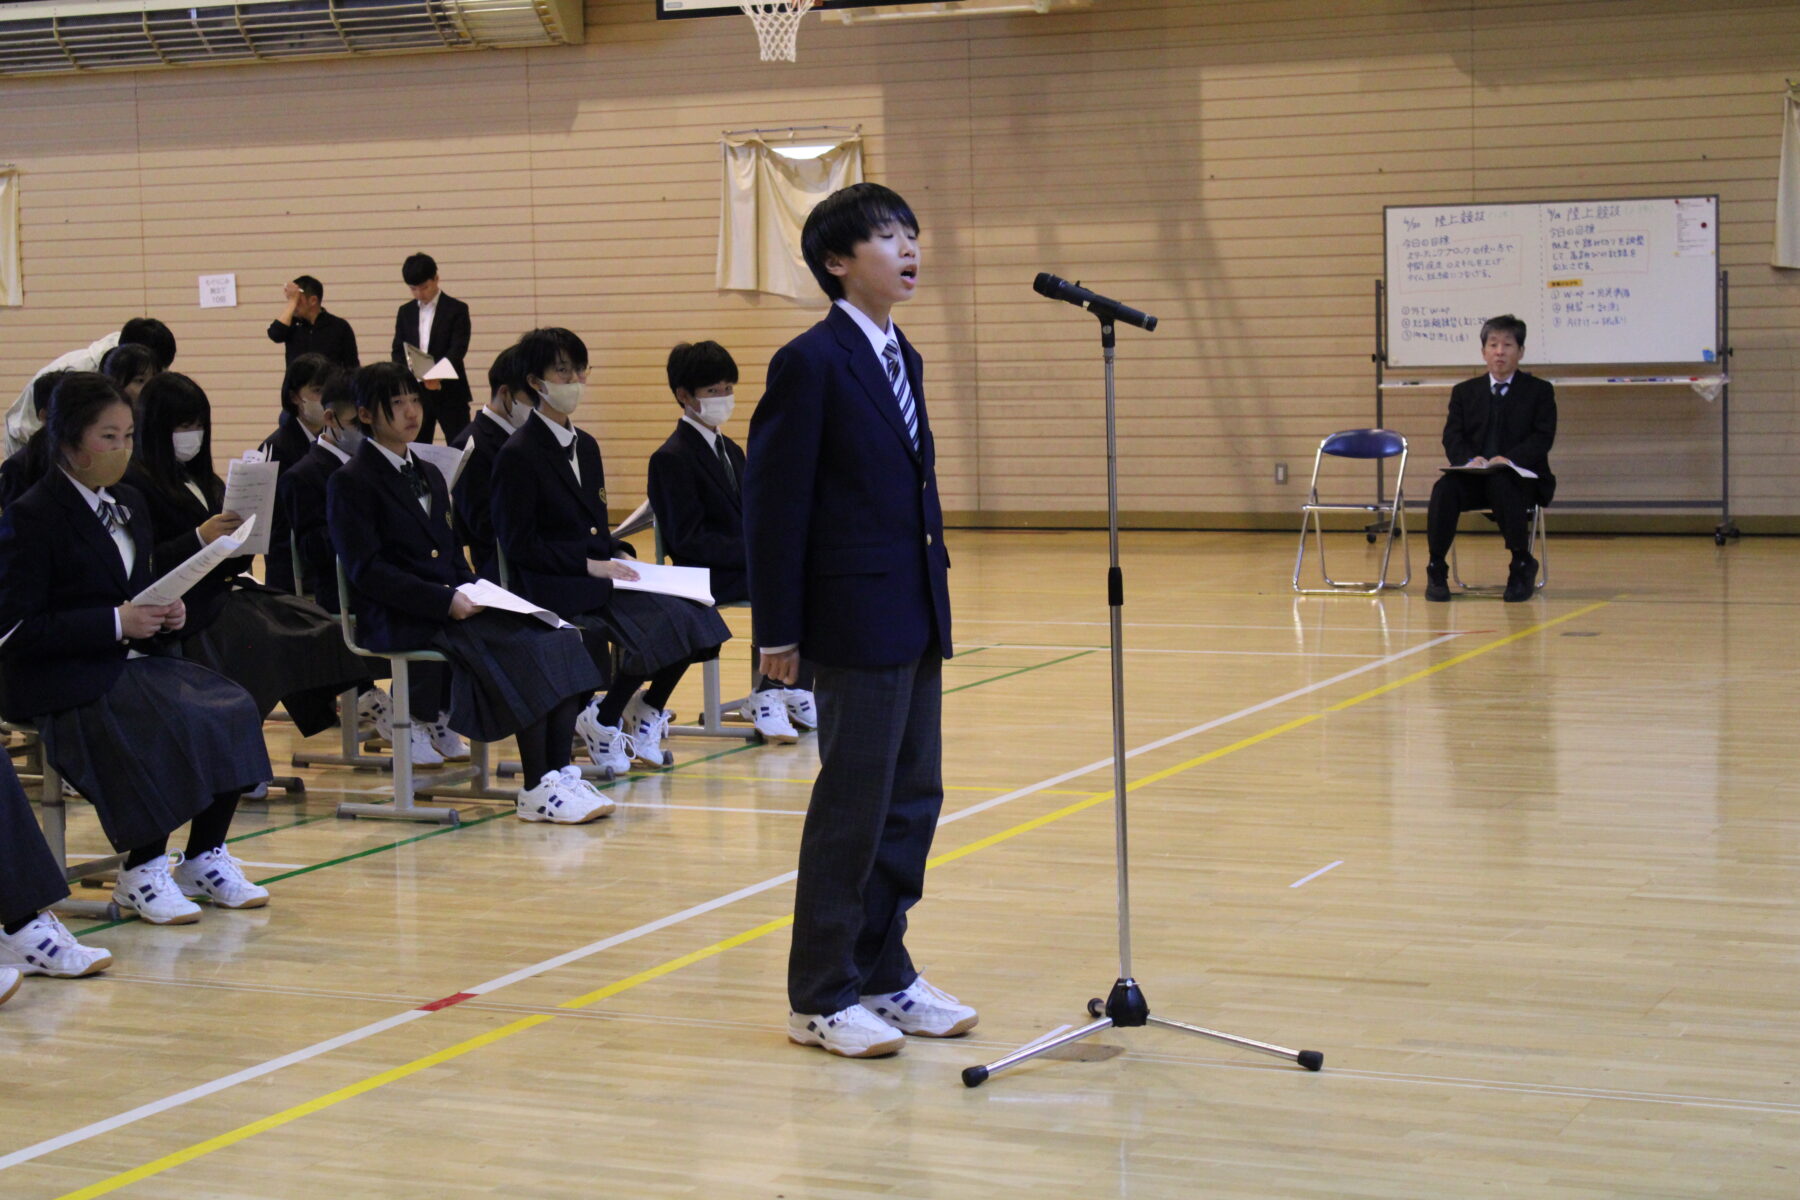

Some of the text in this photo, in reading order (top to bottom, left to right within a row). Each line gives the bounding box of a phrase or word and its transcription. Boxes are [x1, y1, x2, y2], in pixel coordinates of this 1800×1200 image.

[1435, 210, 1486, 227] 陸上競技
[1567, 205, 1620, 222] 陸上競技
[1551, 223, 1595, 238] 今日の目標
[1402, 235, 1450, 248] 今日の目標
